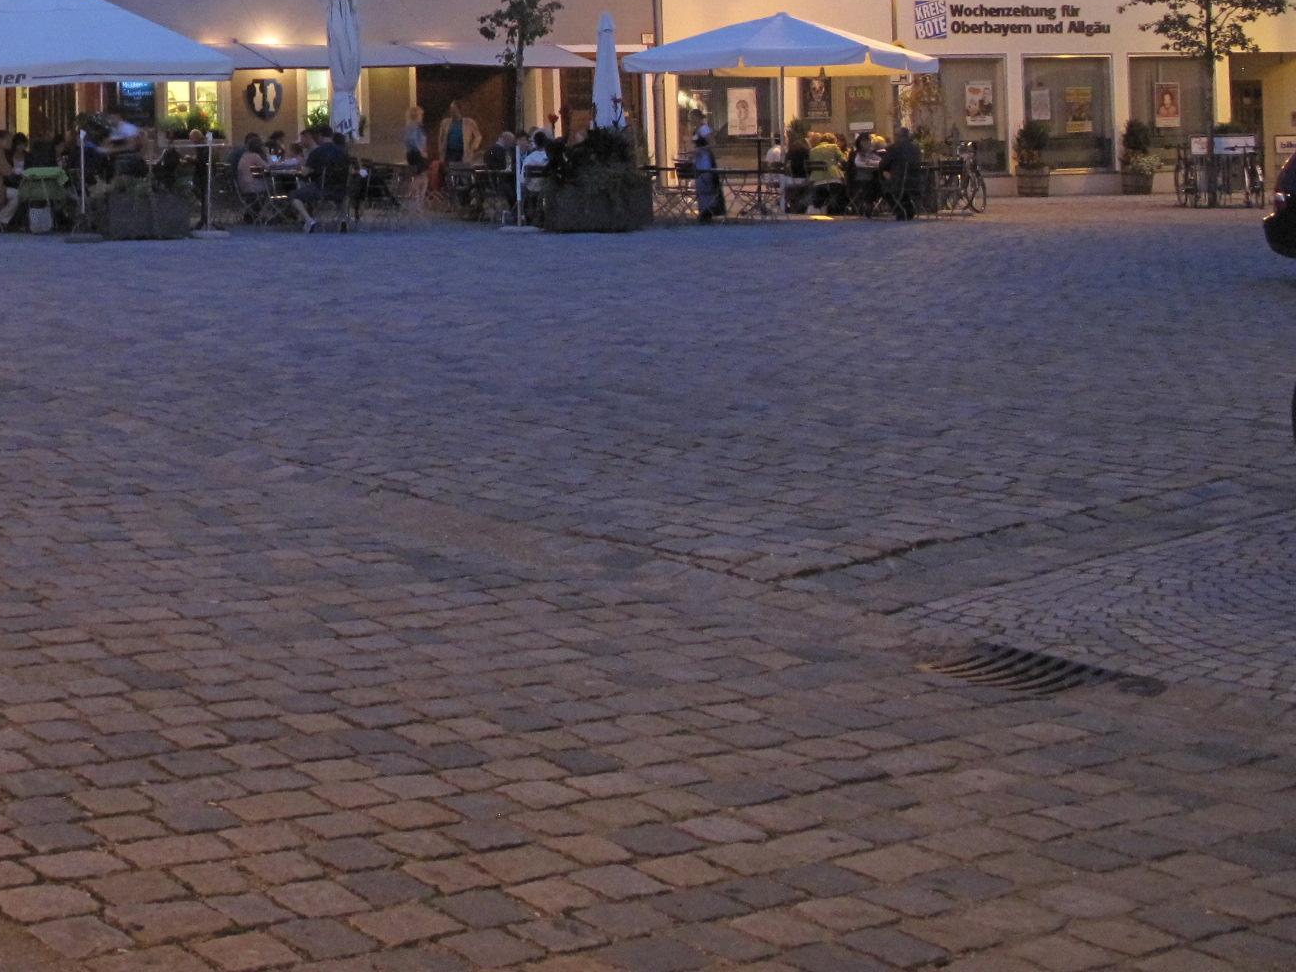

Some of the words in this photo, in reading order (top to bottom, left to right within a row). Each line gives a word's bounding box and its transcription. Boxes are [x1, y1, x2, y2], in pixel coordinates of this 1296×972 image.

[915, 1, 946, 21] KREIS
[950, 4, 1056, 20] Wochenzeitung
[1061, 4, 1080, 17] für
[915, 16, 946, 39] BOTE
[951, 21, 1032, 37] Oberbayern
[1036, 21, 1064, 34] und
[1067, 21, 1111, 37] Allgäu
